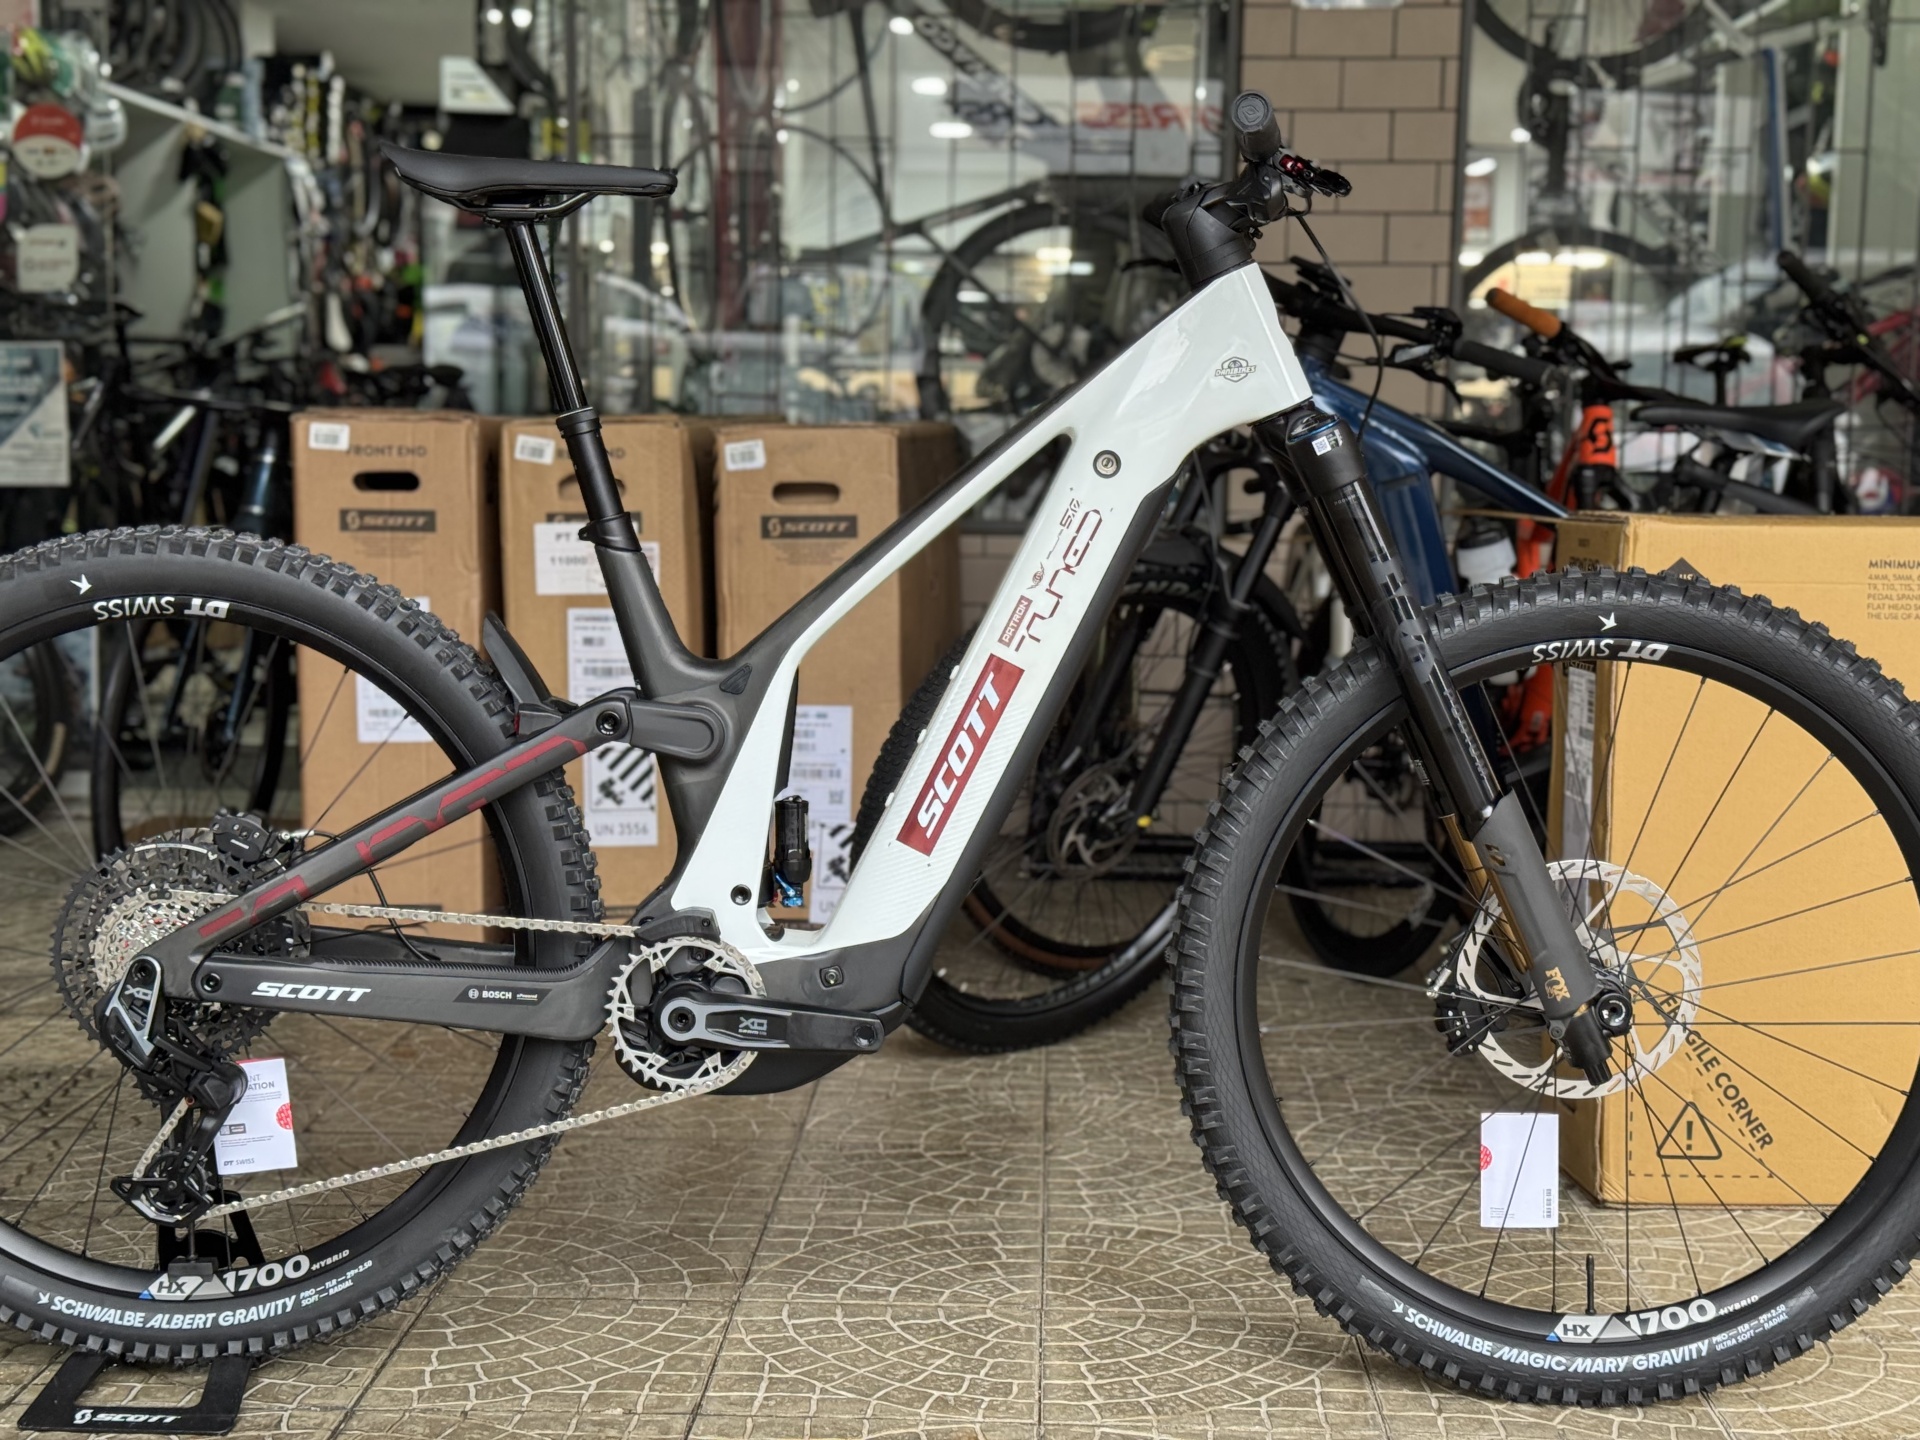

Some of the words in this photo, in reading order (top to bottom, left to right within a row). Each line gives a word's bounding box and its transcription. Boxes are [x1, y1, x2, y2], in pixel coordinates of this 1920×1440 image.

[361, 515, 429, 528] SCOTT
[783, 521, 849, 534] SCOTT
[93, 595, 175, 620] SWISS
[184, 598, 231, 619] DT
[1002, 599, 1029, 643] PATRON
[1532, 639, 1615, 663] SWISS
[1617, 640, 1669, 661] DT
[917, 671, 1000, 839] SCOTT
[251, 981, 371, 1002] SCOTT
[482, 990, 512, 999] BOSCH
[1715, 1072, 1774, 1151] CORNER
[235, 1157, 255, 1166] SWISS
[157, 1281, 187, 1294] HX
[223, 1254, 310, 1293] 1700
[300, 1288, 316, 1300] PRO
[301, 1294, 319, 1308] SOFT
[328, 1279, 354, 1296] RADIAL
[51, 1295, 145, 1328] SCHWALBE
[145, 1312, 216, 1329] ALBERT
[218, 1295, 297, 1327] GRAVITY
[1563, 1323, 1592, 1337] HX
[1625, 1298, 1717, 1335] 1700
[1404, 1308, 1493, 1357] SCHWALBE
[1493, 1346, 1568, 1371] MAGIC
[1567, 1355, 1629, 1374] MARY
[1632, 1338, 1710, 1371] GRAVITY
[1715, 1337, 1738, 1352] ULTRA
[1737, 1329, 1755, 1343] SOFT
[1763, 1312, 1789, 1331] RADIAL
[92, 1413, 182, 1423] SCOTT
